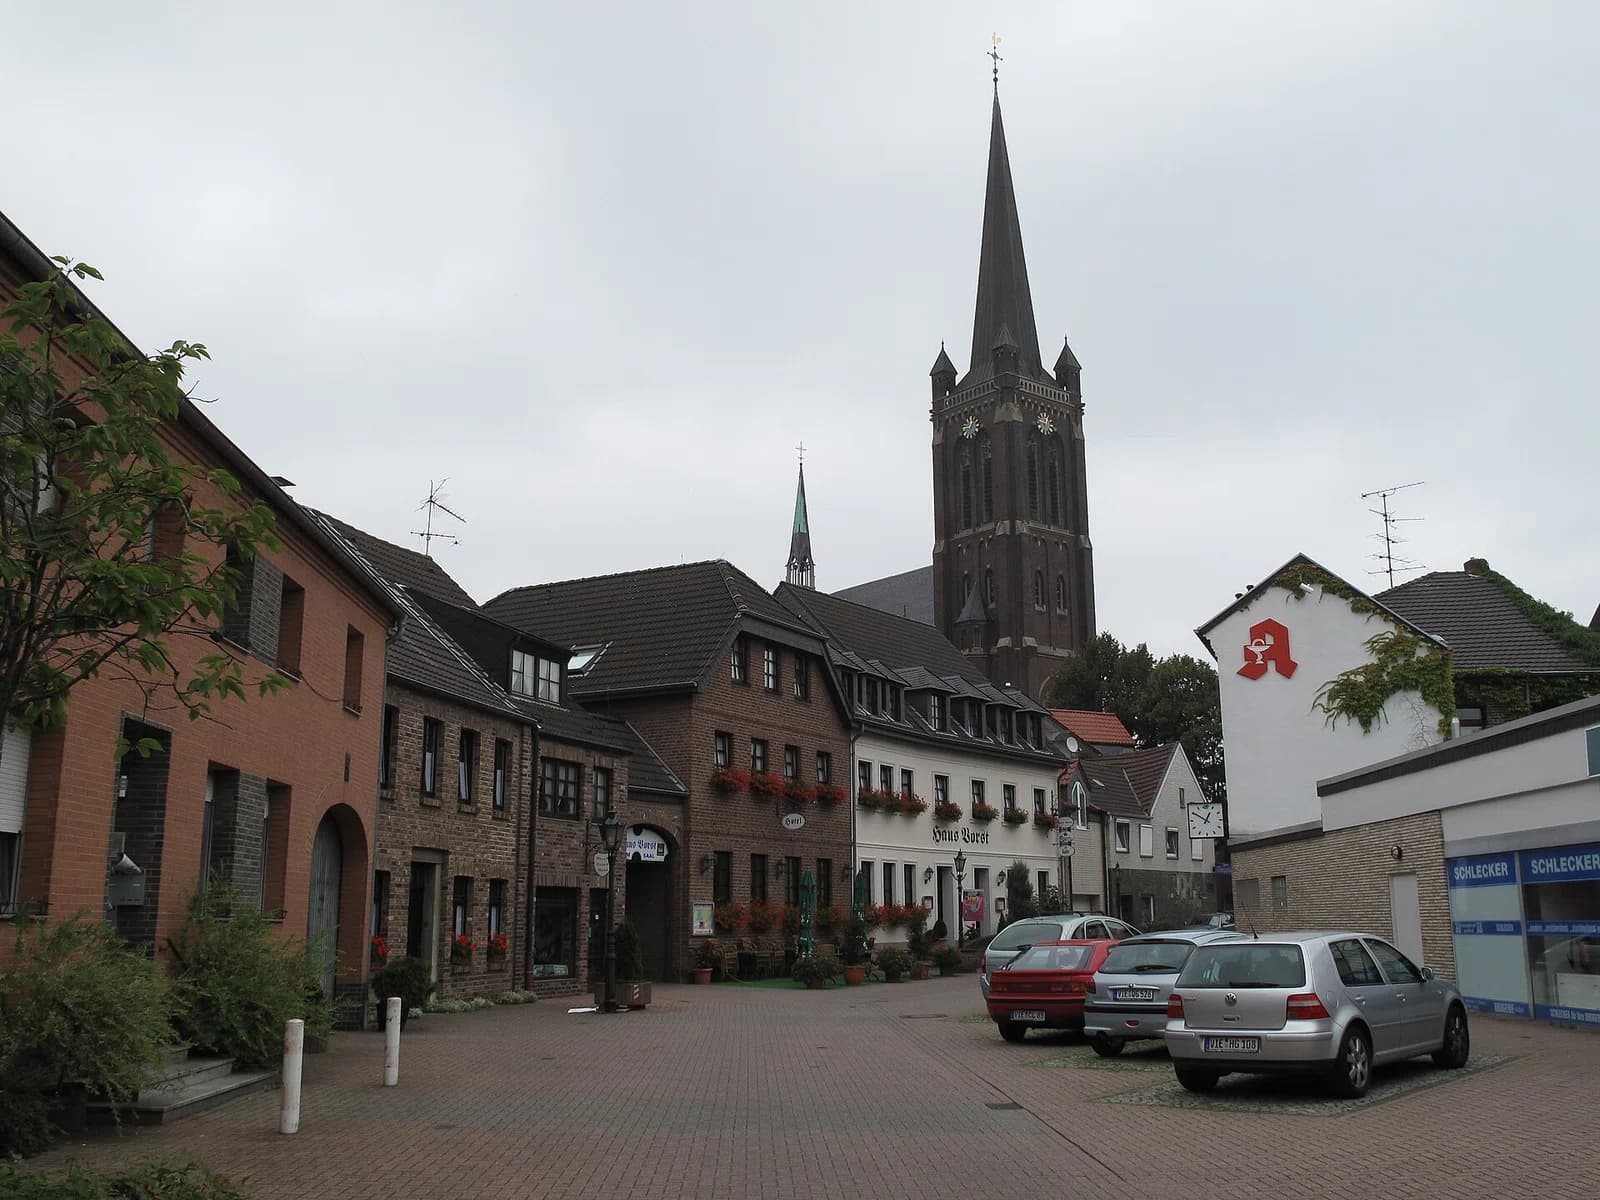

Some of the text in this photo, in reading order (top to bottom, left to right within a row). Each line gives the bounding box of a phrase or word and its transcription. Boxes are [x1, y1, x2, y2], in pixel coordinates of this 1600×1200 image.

[932, 825, 989, 845] Haus Vorst
[638, 839, 657, 850] Vorst
[1453, 862, 1509, 880] SCHLECKER
[1531, 854, 1600, 874] SCHLECKER
[1210, 1039, 1224, 1049] VIE
